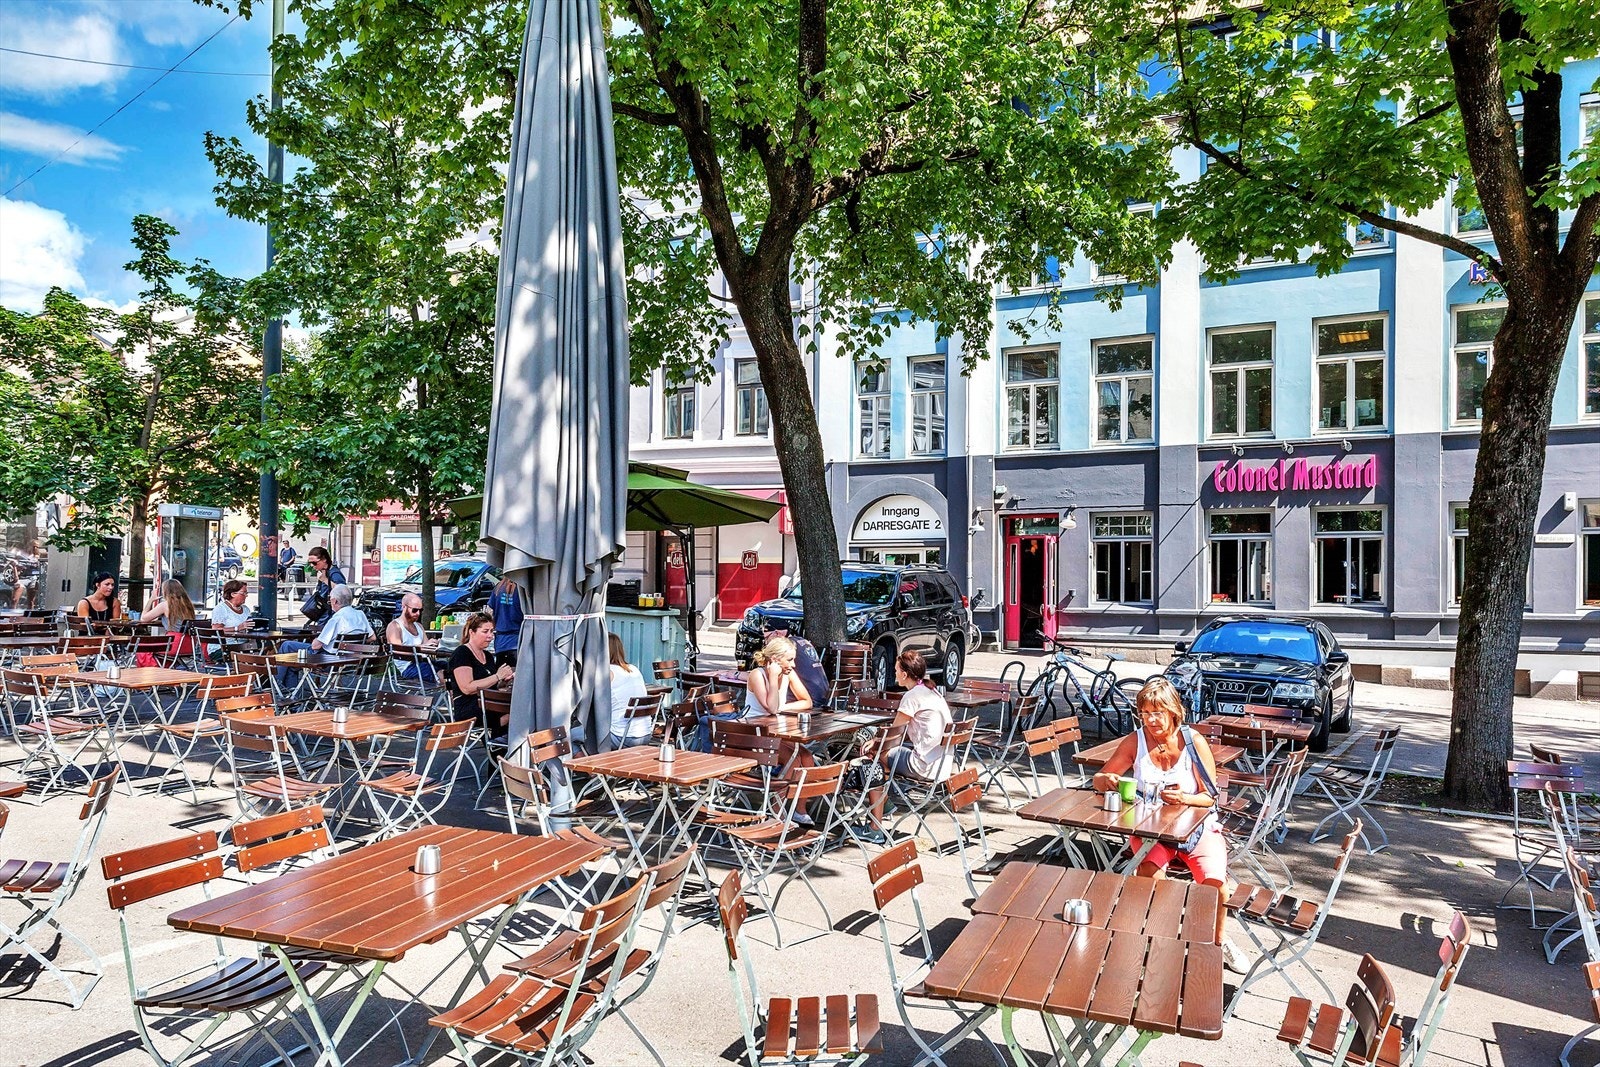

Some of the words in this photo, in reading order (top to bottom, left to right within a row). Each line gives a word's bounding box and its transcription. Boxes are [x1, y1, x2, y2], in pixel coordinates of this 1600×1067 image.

[1214, 458, 1286, 492] Colonel
[1292, 454, 1376, 491] Mustard
[882, 506, 920, 518] Inngang
[863, 519, 930, 531] DARRESGATE
[935, 519, 942, 530] 2
[386, 544, 419, 552] BESTILL
[745, 554, 756, 567] deli
